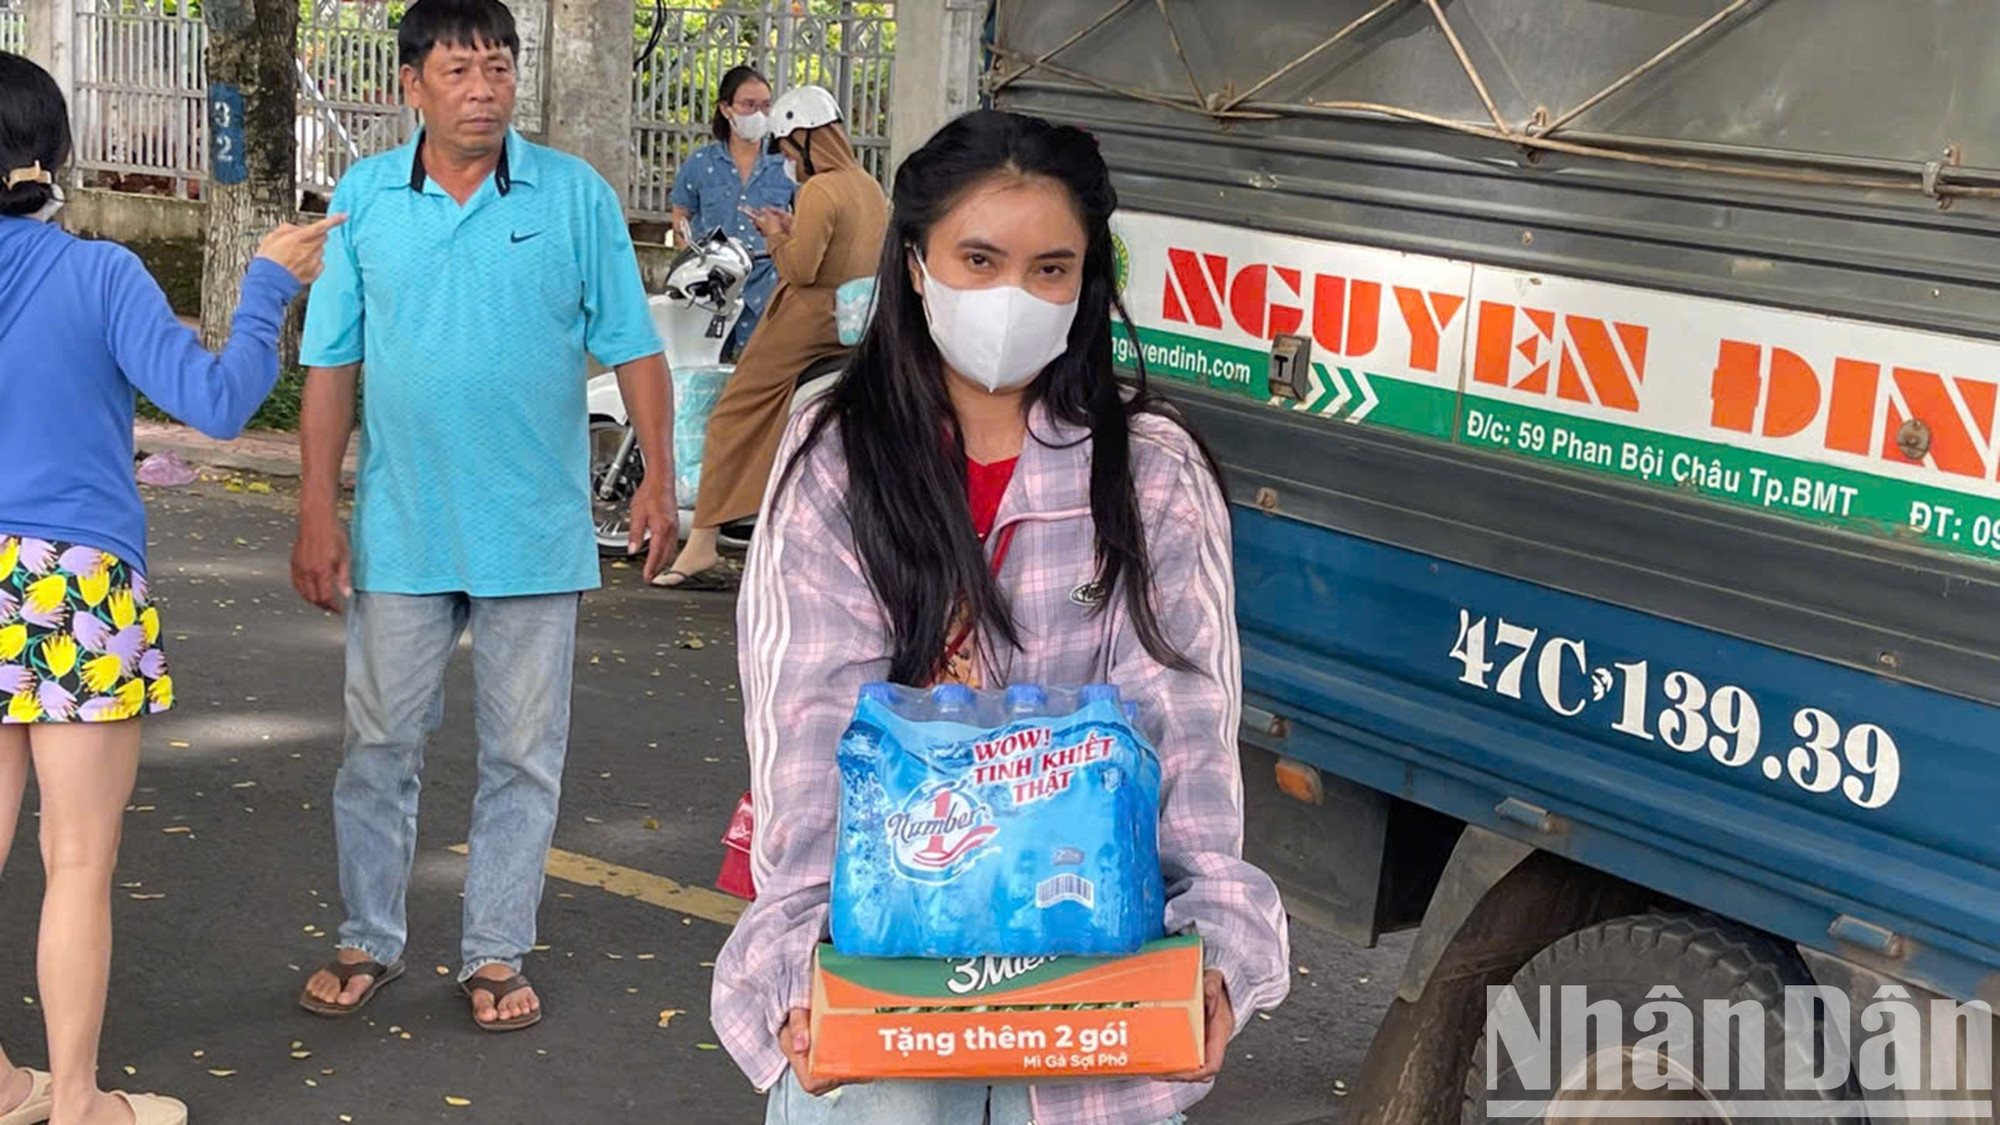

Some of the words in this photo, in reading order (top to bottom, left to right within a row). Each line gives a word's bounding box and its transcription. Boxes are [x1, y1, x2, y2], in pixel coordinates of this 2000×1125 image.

[1163, 247, 1649, 412] NGUYEN
[1711, 338, 2000, 483] ĐIN
[1273, 354, 1288, 378] T
[1467, 410, 1511, 444] Đ/c:
[1517, 421, 1546, 451] 59
[1552, 428, 1612, 466] Phan
[1620, 442, 1664, 480] Bội
[1671, 452, 1741, 493] Châu
[1749, 467, 1858, 517] Tp.BMT
[1909, 501, 1962, 541] ĐT:
[974, 728, 1051, 762] WOW!
[975, 757, 1032, 785] TINH
[1042, 728, 1114, 772] KHIẾT
[1013, 769, 1074, 804] THẬT
[887, 802, 987, 844] Number
[947, 956, 980, 994] 3
[878, 1026, 955, 1057] Tặng
[963, 1025, 1047, 1050] thêm
[1053, 1025, 1073, 1049] 2
[1079, 1021, 1128, 1052] gói
